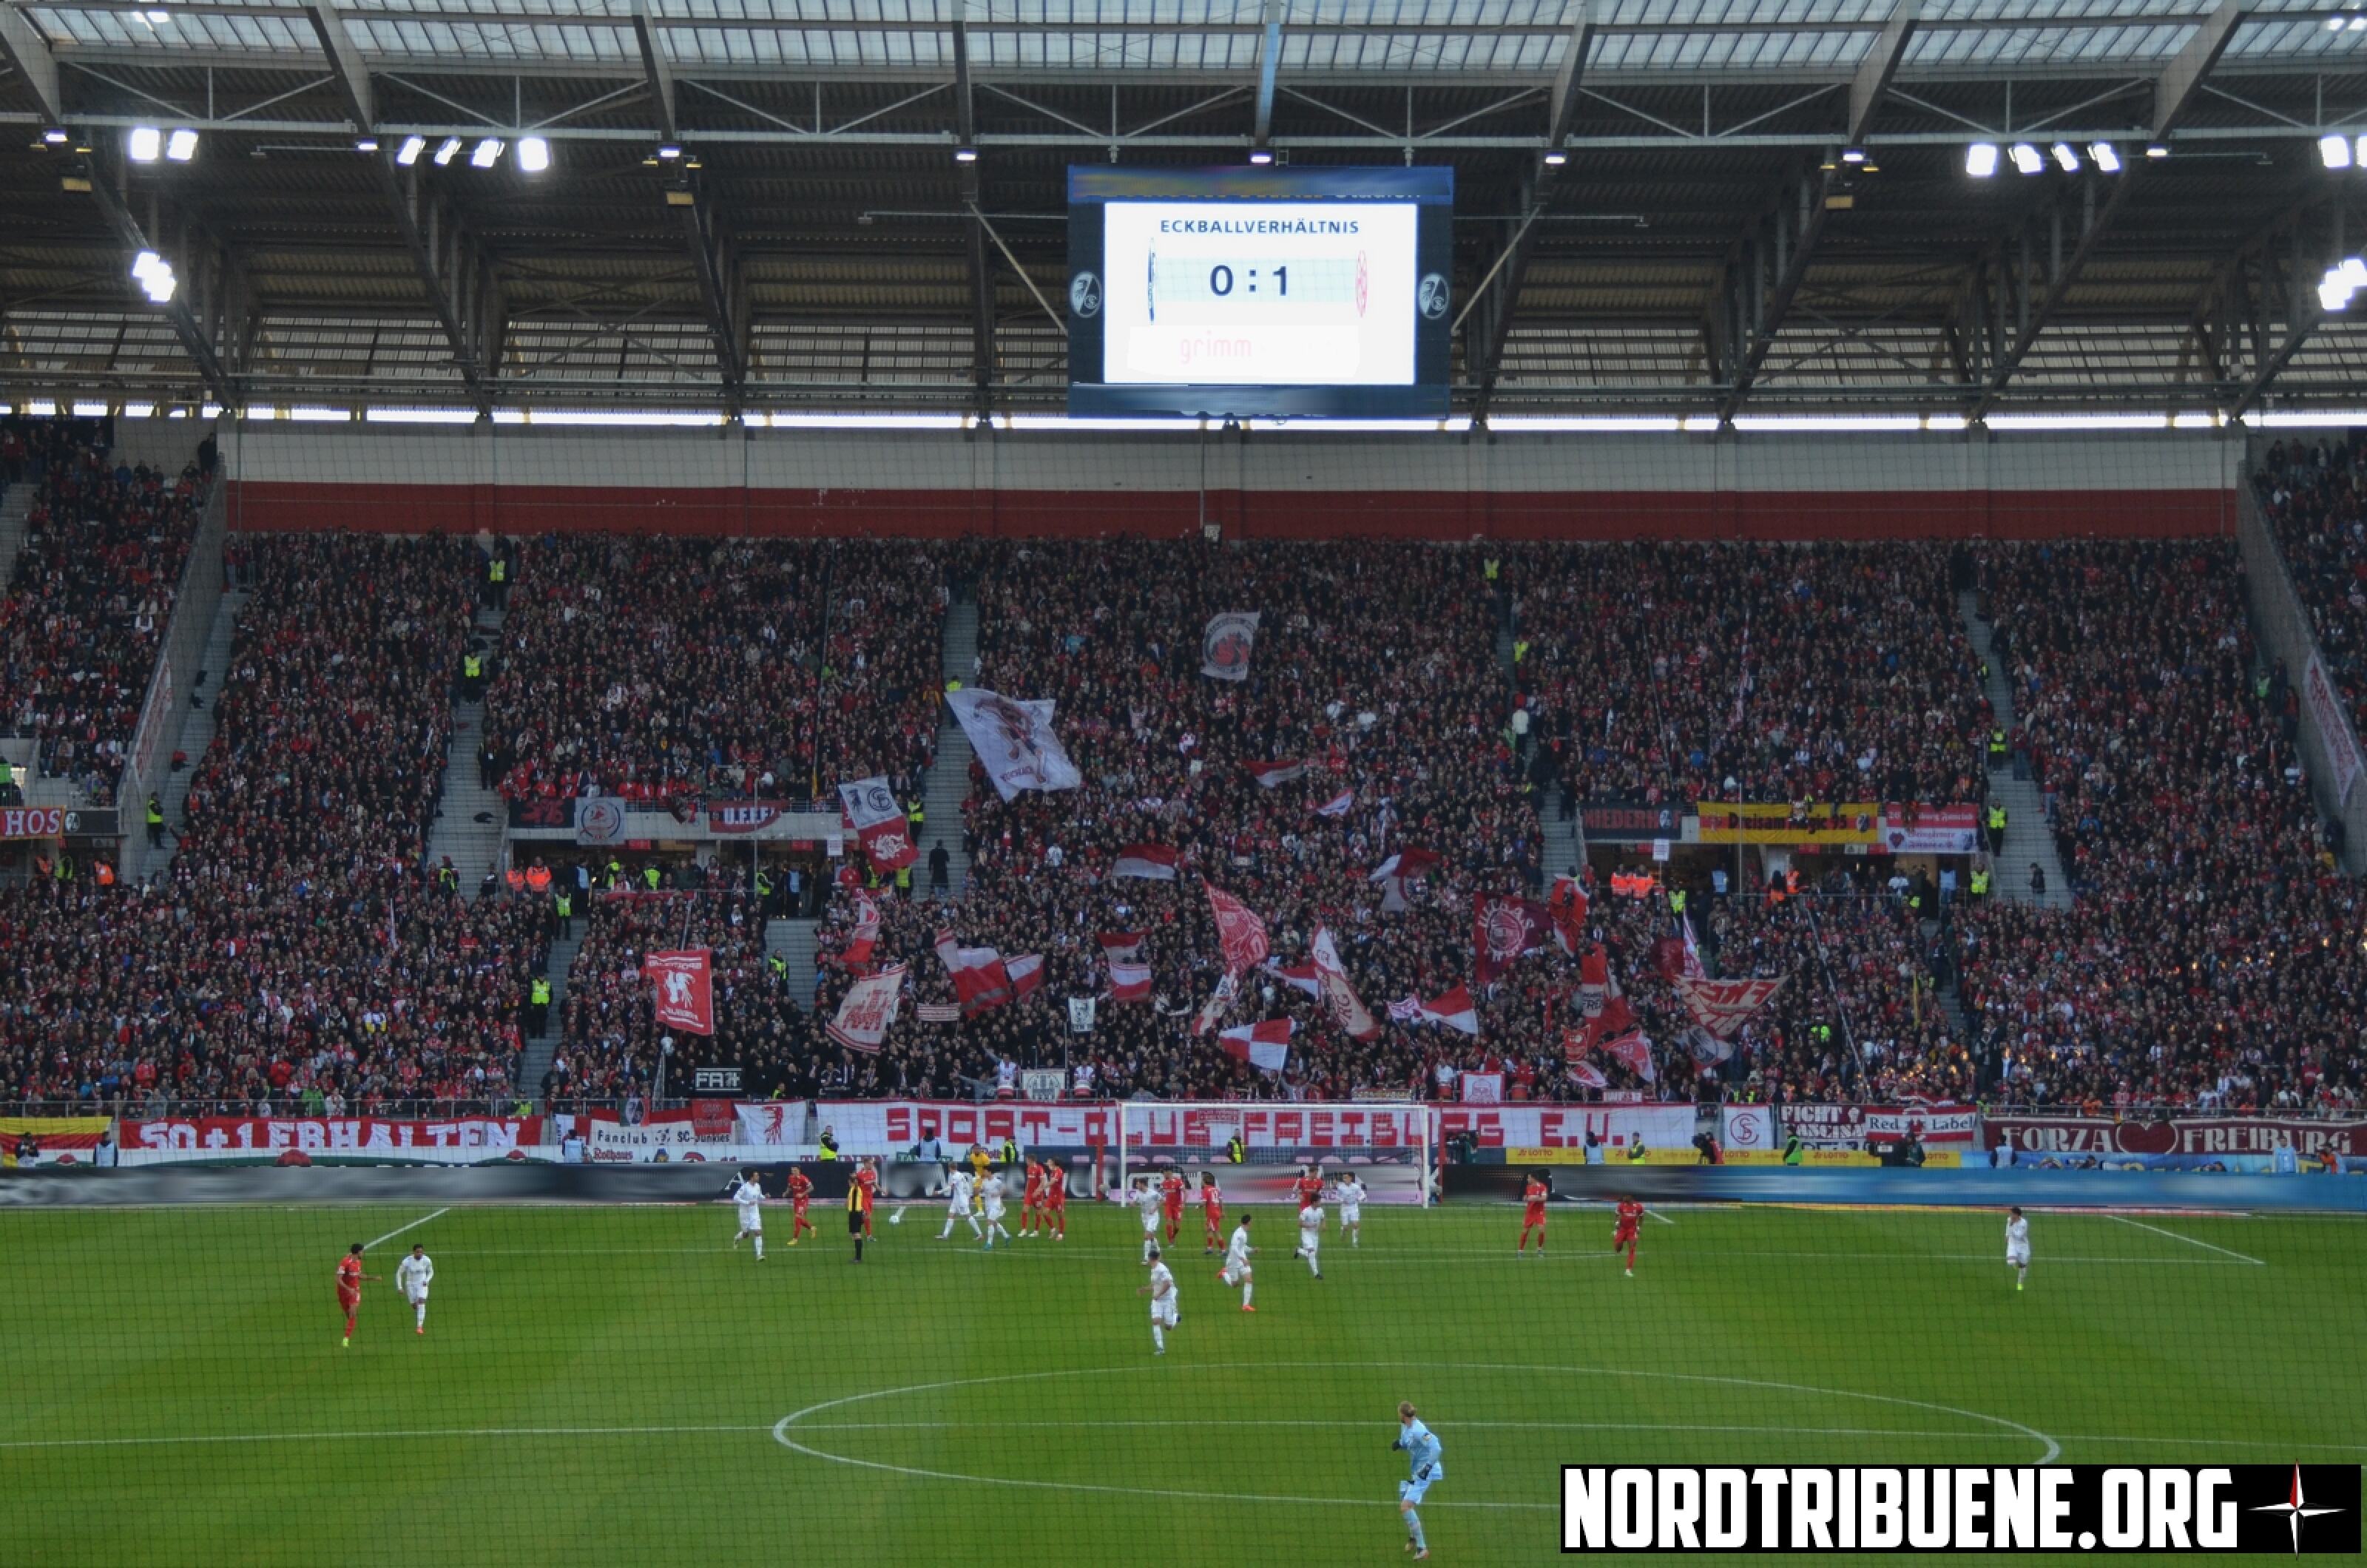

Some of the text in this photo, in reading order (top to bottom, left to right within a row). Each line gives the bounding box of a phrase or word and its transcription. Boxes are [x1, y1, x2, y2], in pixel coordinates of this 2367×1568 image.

[1161, 217, 1360, 234] ECKBALLVERHÄLTNIS
[1869, 1115, 1976, 1130] Red Label
[597, 1129, 647, 1144] Fanclub
